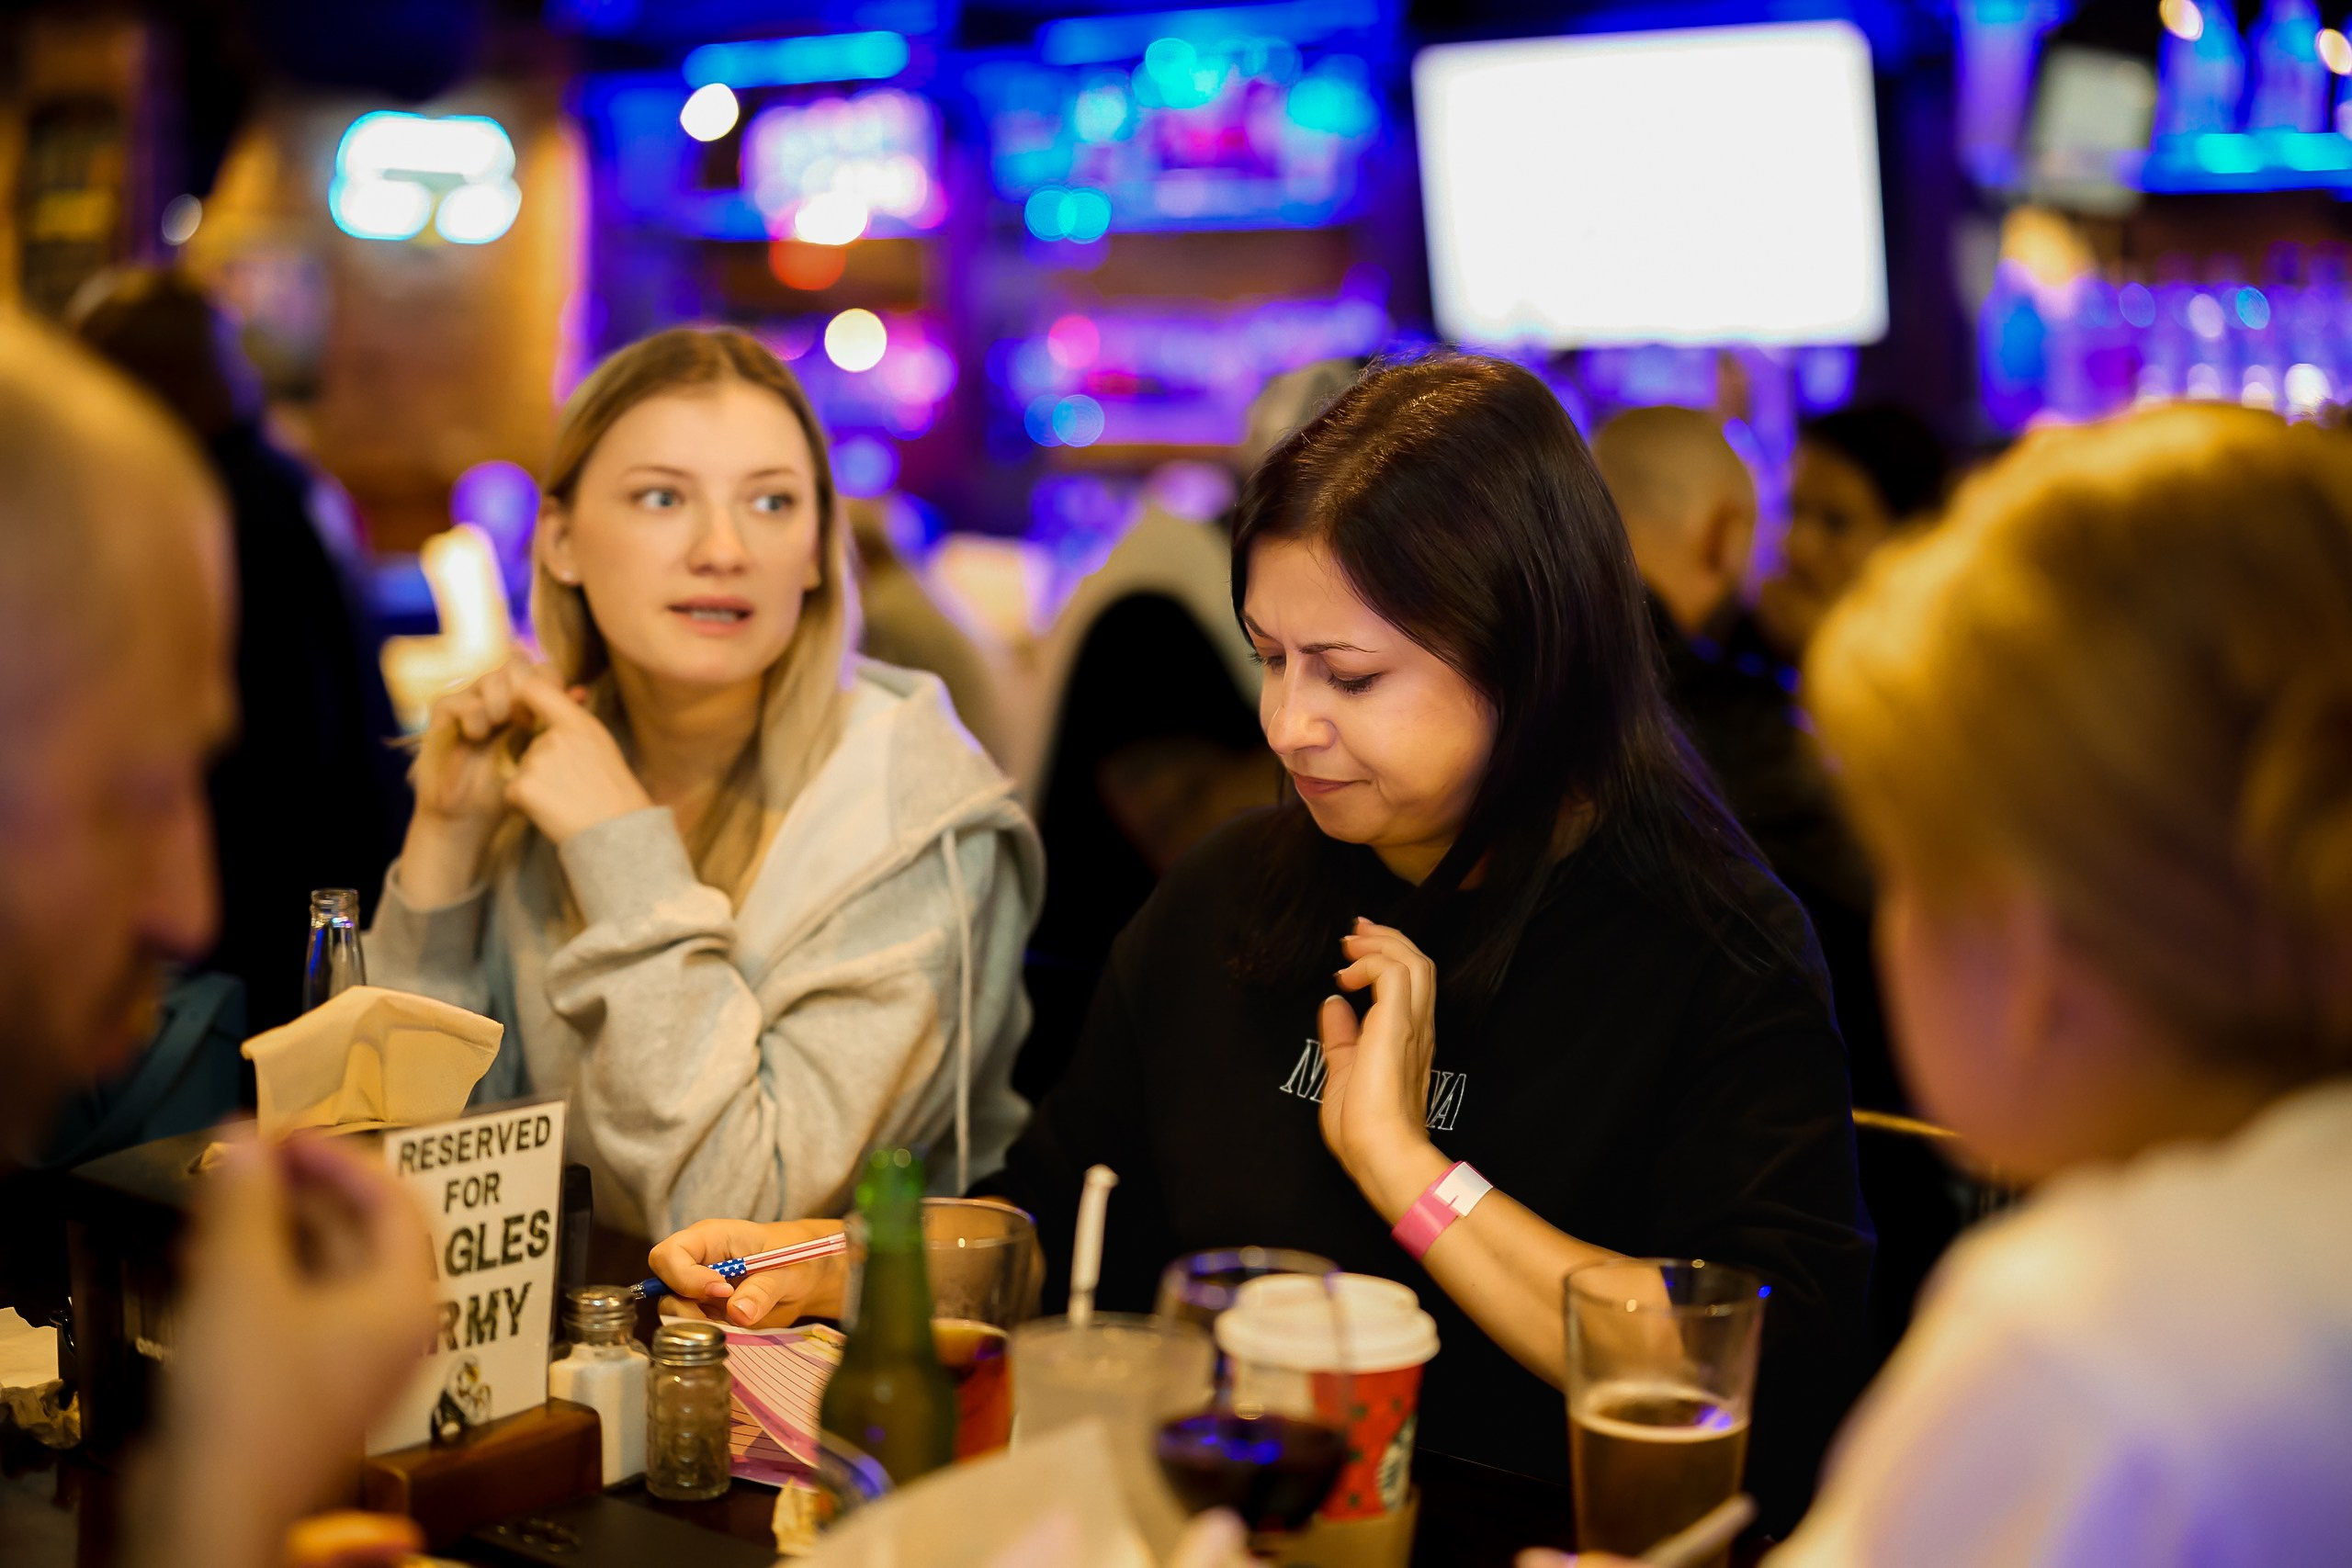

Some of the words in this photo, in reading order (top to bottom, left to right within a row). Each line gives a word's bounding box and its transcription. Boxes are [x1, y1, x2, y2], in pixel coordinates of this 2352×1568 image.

[399, 1114, 551, 1177] RESERVED
[445, 1172, 502, 1214] FOR
[426, 1209, 551, 1280] GLES
[426, 1281, 533, 1356] RMY
